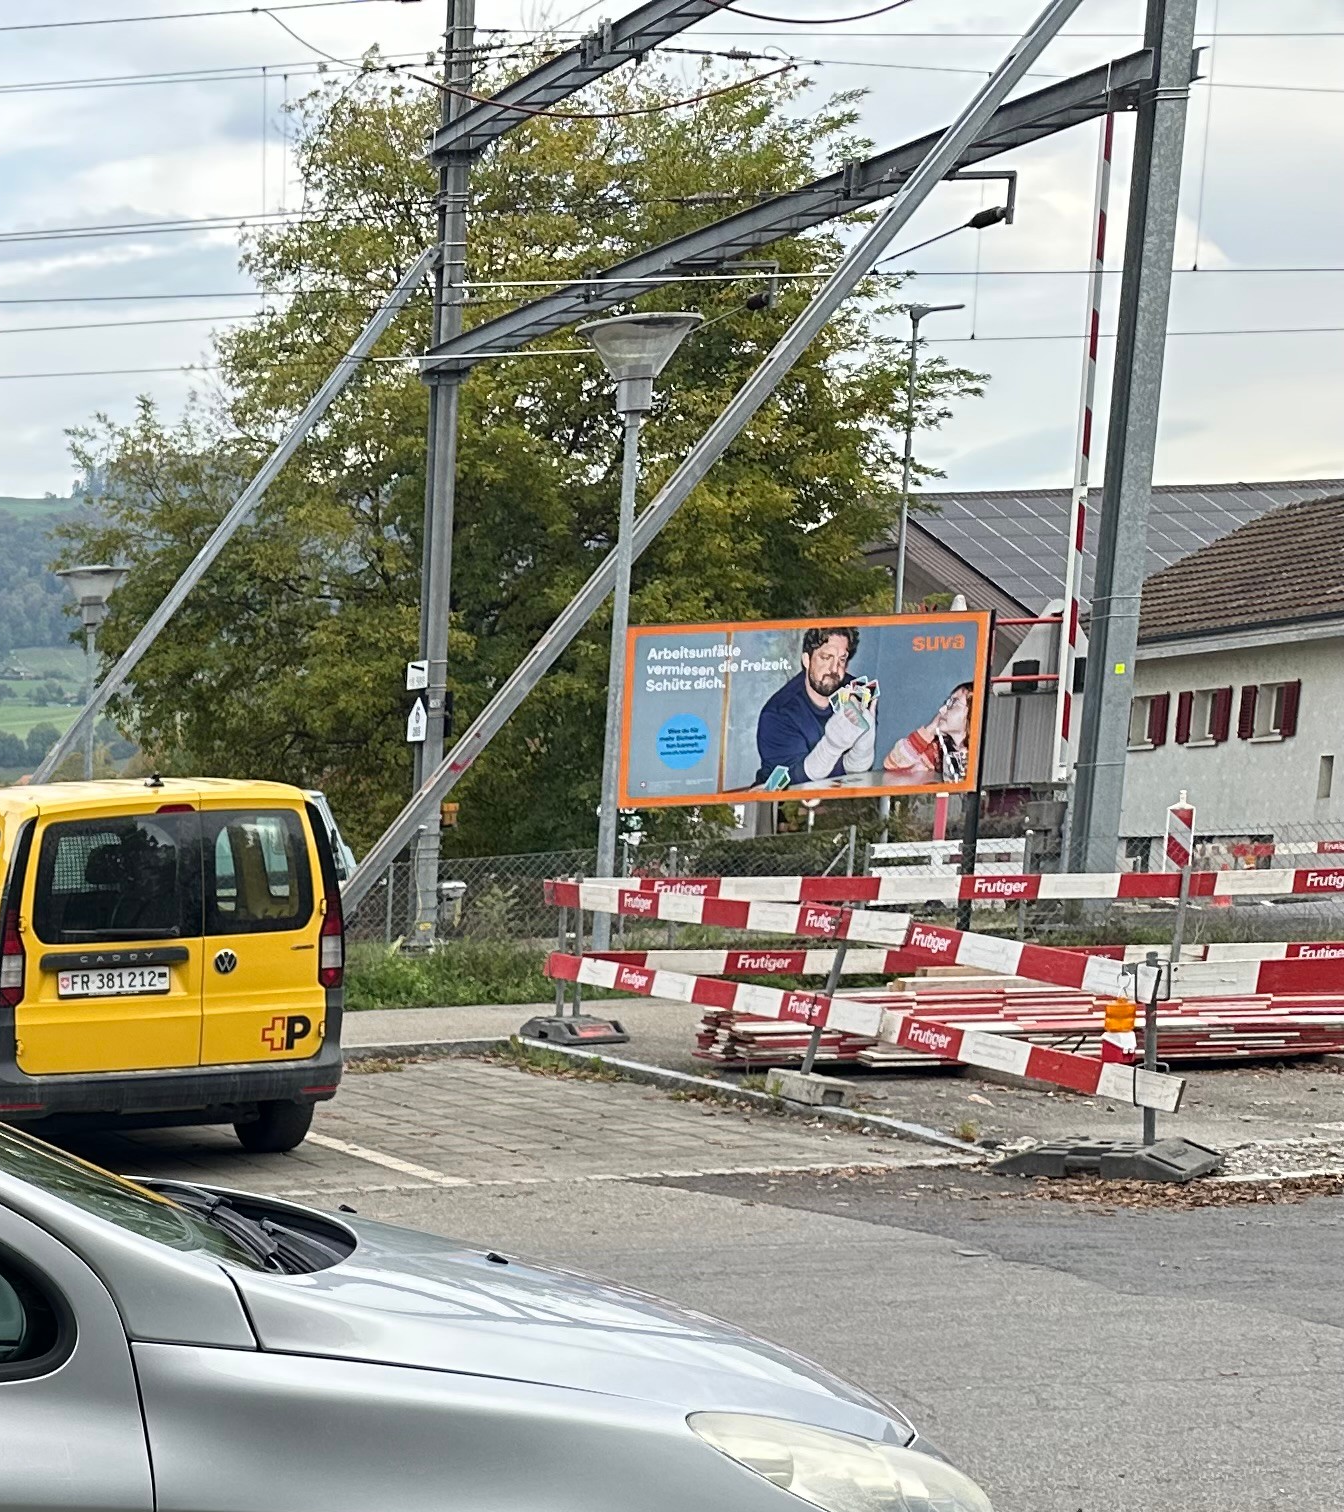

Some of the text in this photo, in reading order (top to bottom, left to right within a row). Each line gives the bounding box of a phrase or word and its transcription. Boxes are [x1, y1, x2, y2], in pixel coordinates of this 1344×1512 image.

[912, 634, 965, 651] suva
[647, 644, 741, 660] Arbeitsunfälle
[646, 658, 792, 677] vermiesen die Freizeit.
[645, 676, 726, 692] Schütz dich.
[974, 878, 1028, 896] Frutiger
[624, 892, 653, 912] Frutiger
[911, 927, 951, 954] Frutiger
[79, 952, 154, 964] CADDY
[737, 954, 792, 972] Frutiger
[620, 966, 649, 989] Frutiger
[907, 1022, 952, 1050] Frutiger
